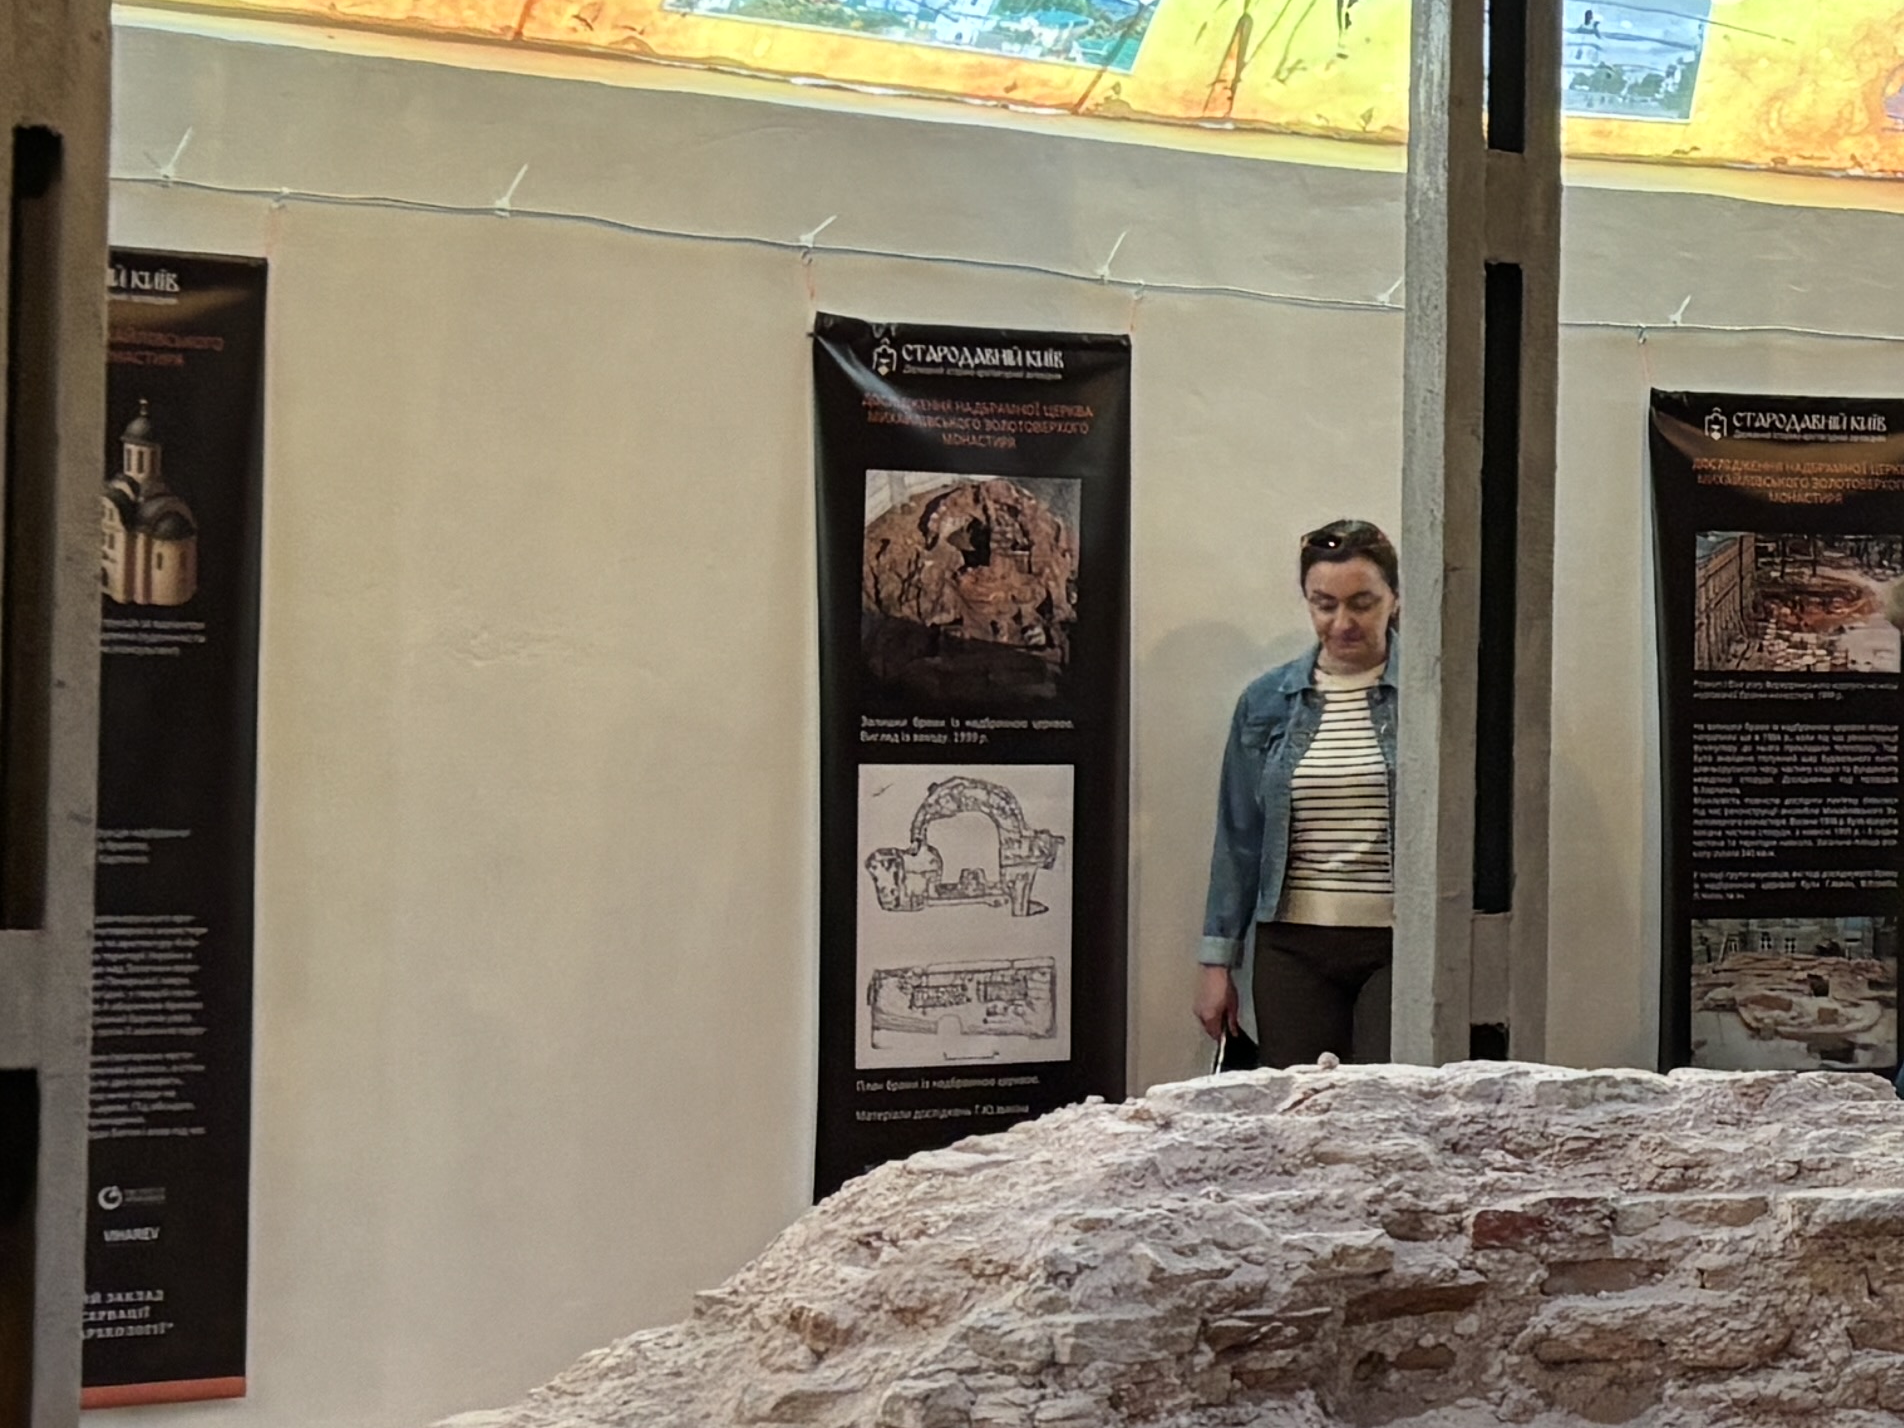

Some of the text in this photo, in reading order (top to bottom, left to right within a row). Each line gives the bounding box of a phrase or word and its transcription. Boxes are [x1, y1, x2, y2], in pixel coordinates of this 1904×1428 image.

[1025, 348, 1064, 369] КИЇВ
[1732, 411, 1888, 432] СТАРОДАВНІЙ КИЇВ
